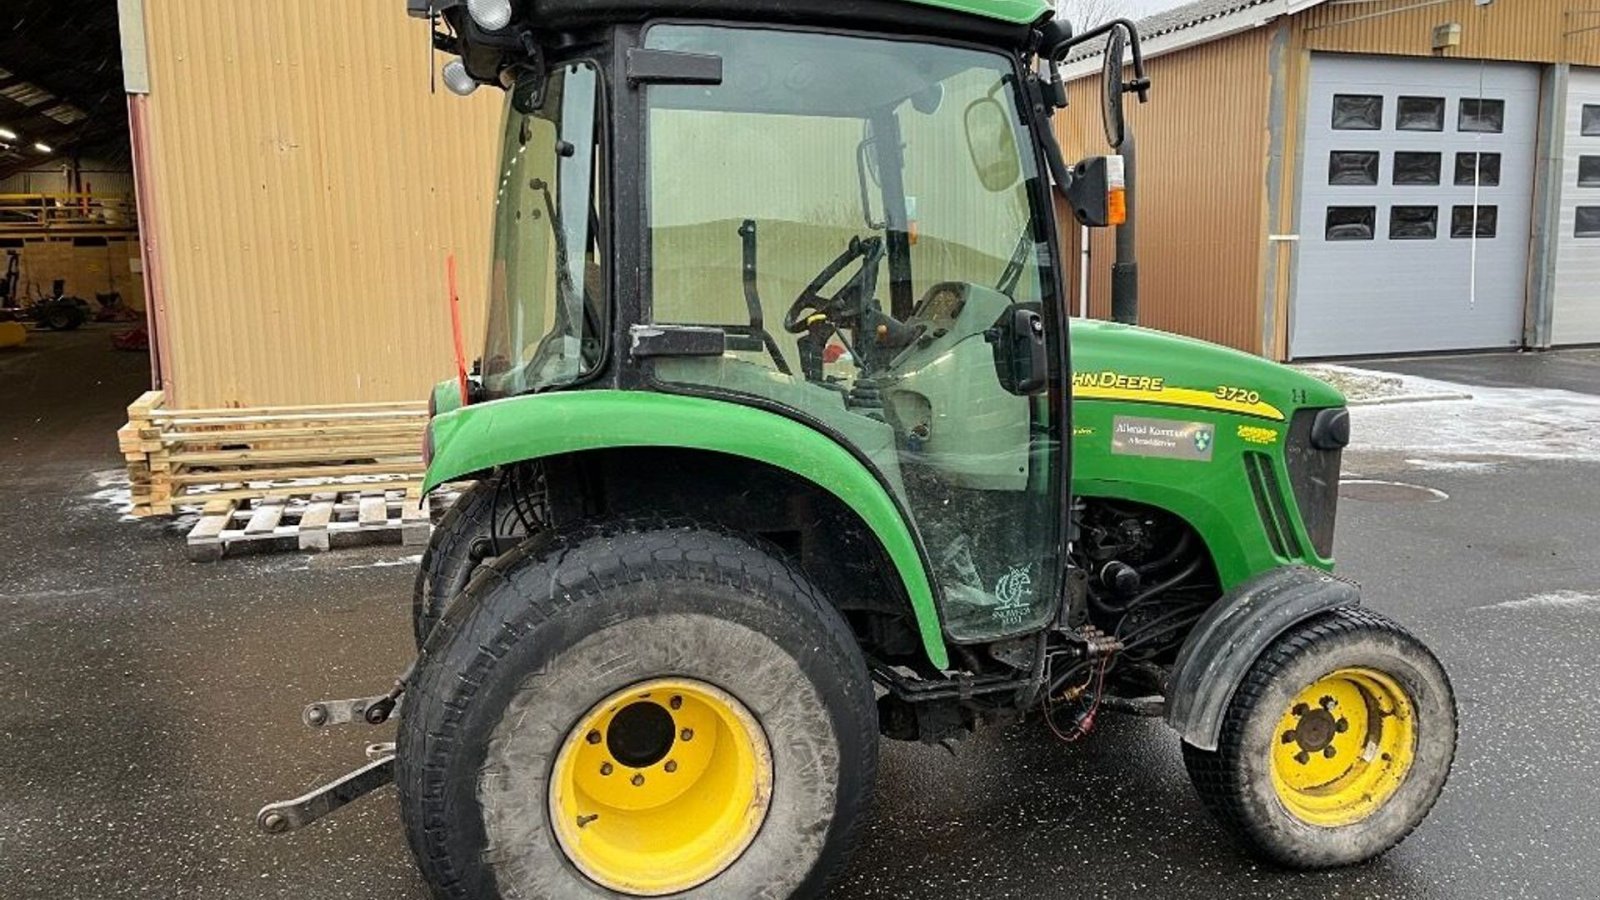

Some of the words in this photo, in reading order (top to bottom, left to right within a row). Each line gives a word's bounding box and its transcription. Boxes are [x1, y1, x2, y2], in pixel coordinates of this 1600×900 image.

[1072, 372, 1099, 387] HN
[1099, 371, 1164, 392] DEERE
[1215, 385, 1260, 404] 3720
